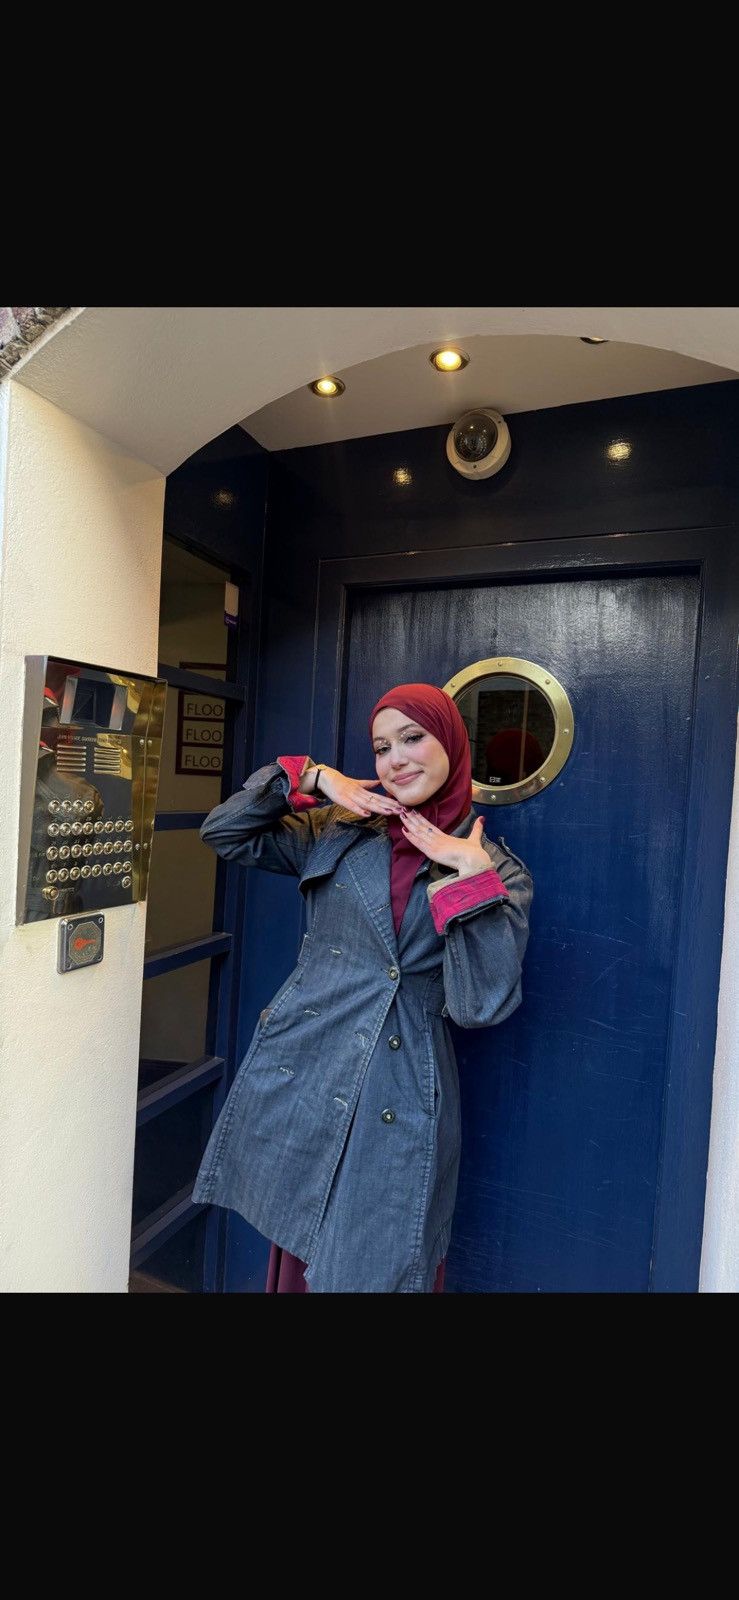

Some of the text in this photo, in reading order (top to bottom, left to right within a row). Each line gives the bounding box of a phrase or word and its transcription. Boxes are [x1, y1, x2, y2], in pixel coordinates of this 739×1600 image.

[186, 703, 223, 717] FLOO
[186, 729, 222, 742] FLOO
[184, 755, 221, 768] FLOO
